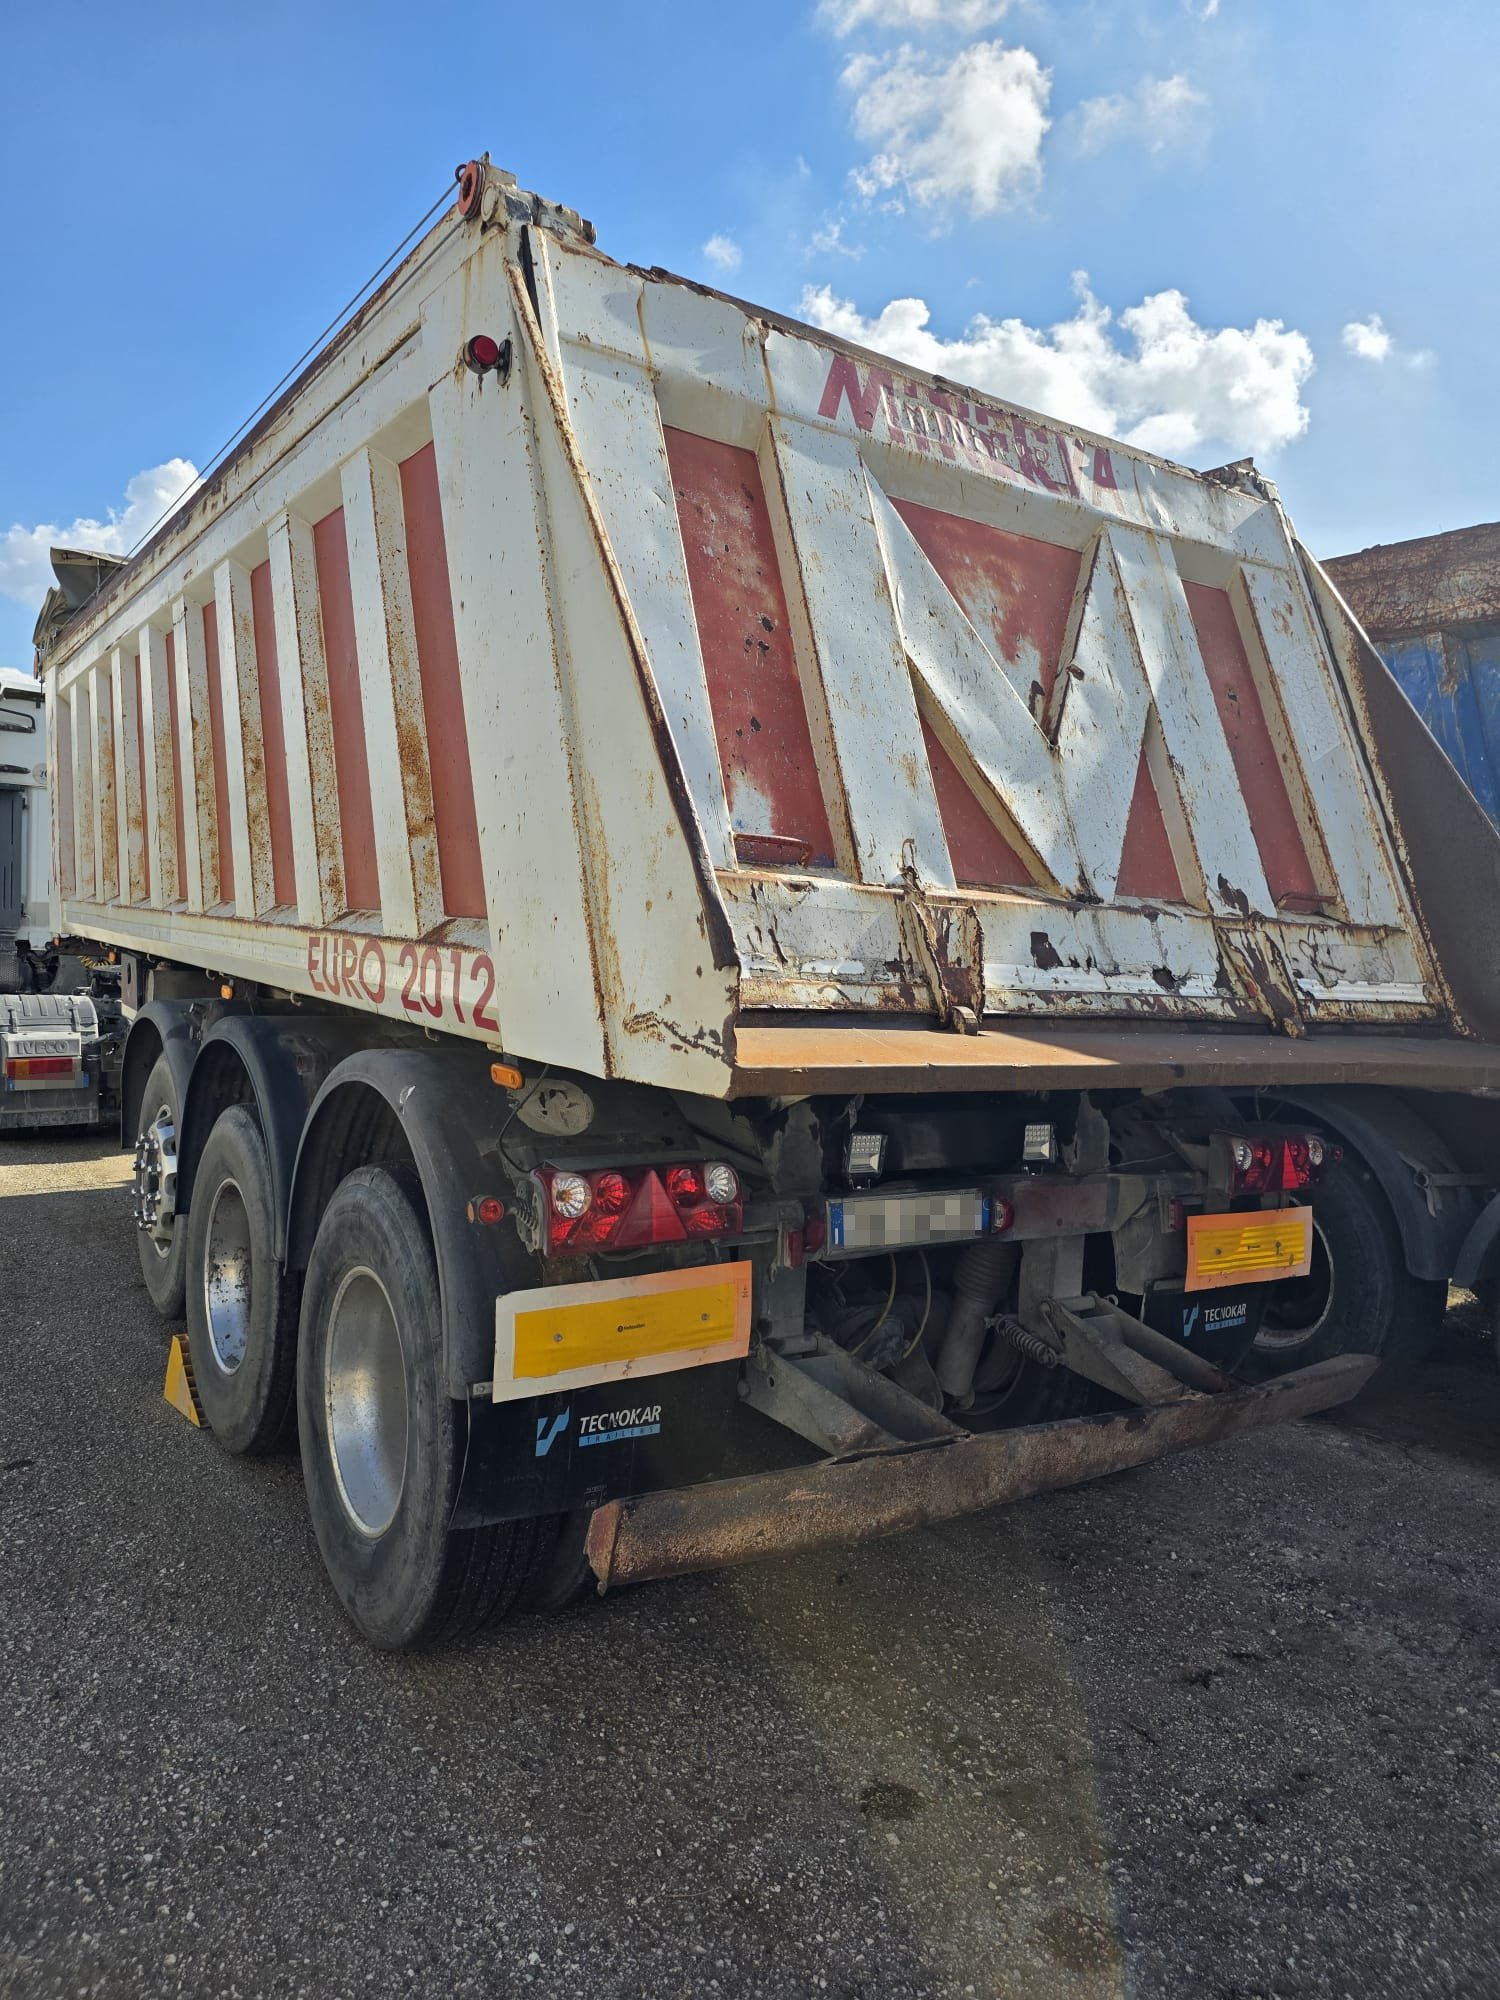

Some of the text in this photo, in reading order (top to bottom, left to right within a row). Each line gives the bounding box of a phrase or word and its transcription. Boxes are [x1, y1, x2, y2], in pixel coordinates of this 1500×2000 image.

[308, 936, 500, 1032] EURO 2012
[16, 1040, 69, 1055] IVECO
[1204, 1303, 1247, 1322] TECNOKAR
[580, 1405, 662, 1434] TECNOKAR
